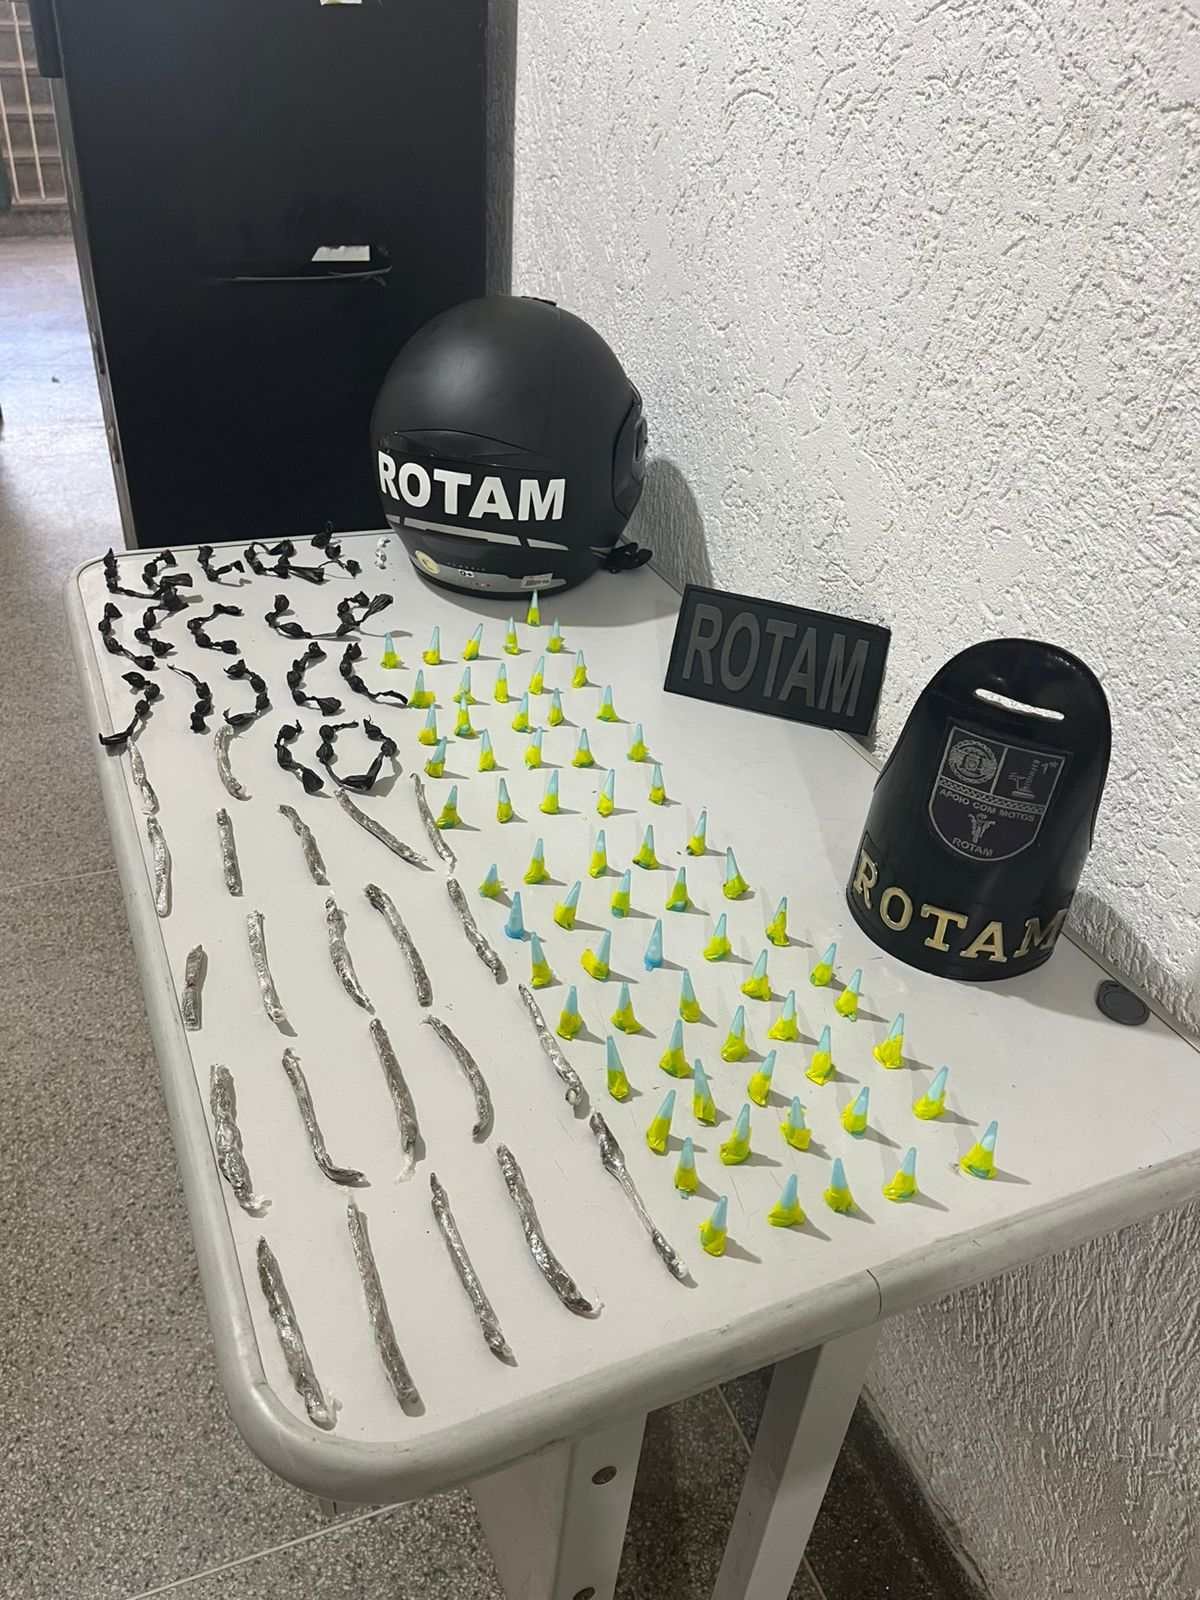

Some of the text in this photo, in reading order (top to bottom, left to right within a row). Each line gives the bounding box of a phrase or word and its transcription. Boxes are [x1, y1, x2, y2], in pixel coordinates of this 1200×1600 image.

[378, 450, 566, 521] ROTAM
[682, 603, 870, 717] ROTAM
[940, 788, 970, 805] APOIO
[973, 801, 996, 815] COM
[952, 837, 993, 857] ROTAM
[854, 850, 1068, 962] ROTAM
